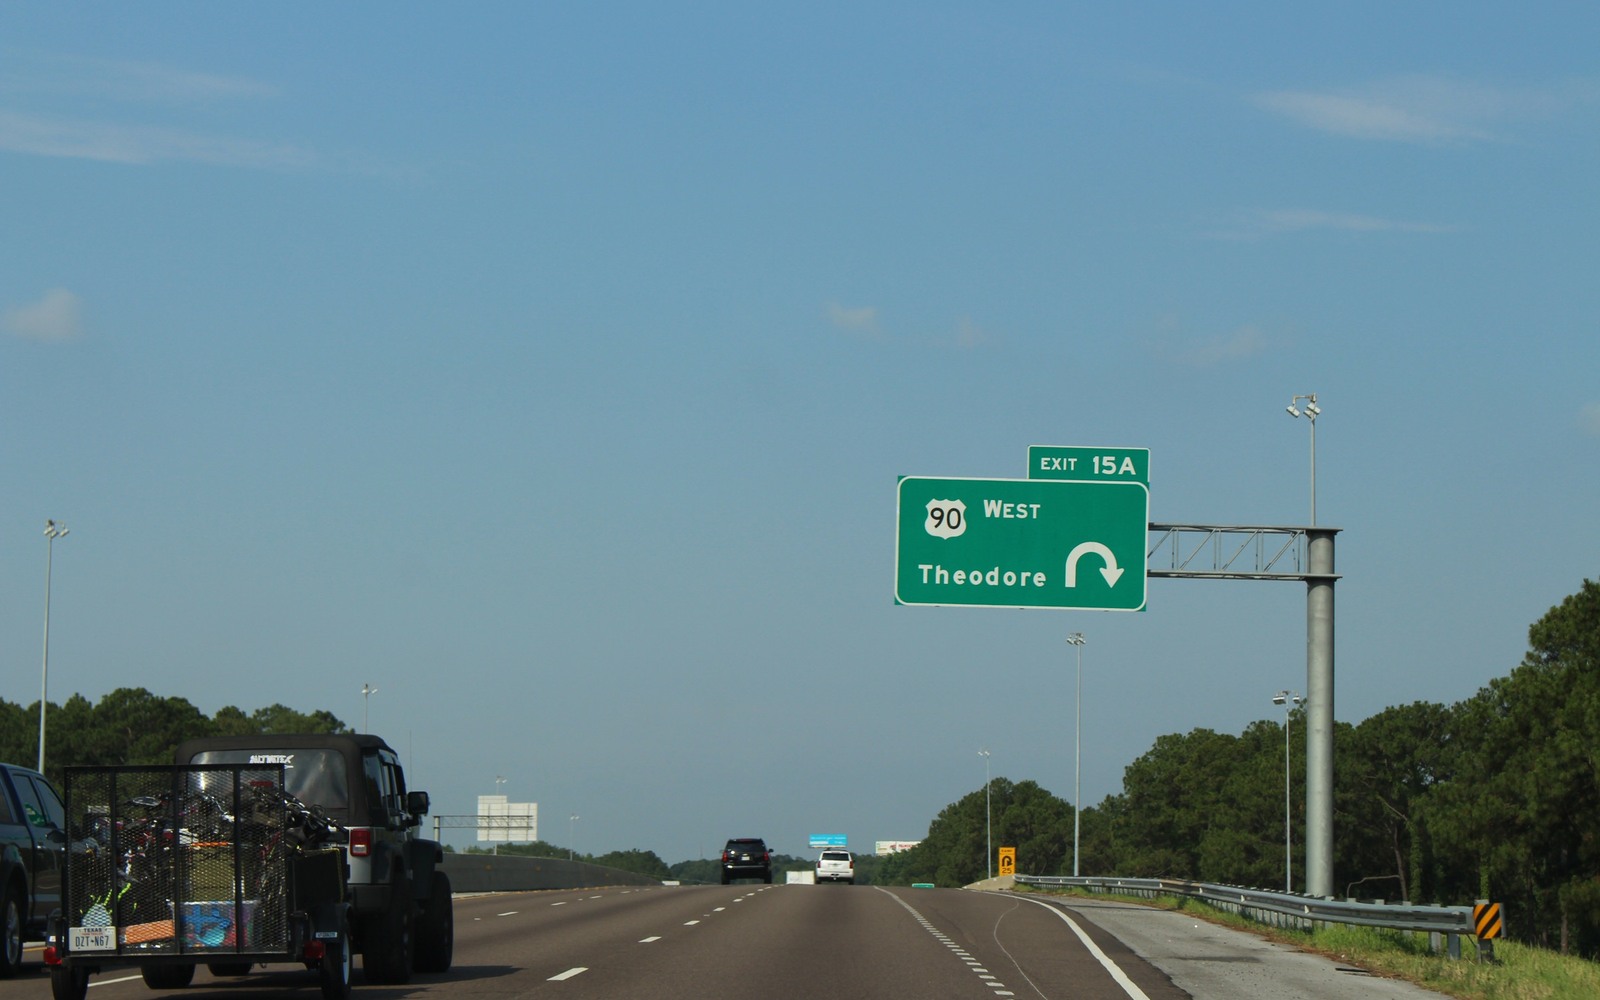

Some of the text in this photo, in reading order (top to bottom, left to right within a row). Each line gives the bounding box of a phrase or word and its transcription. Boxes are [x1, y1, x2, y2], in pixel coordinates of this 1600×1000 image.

[1040, 456, 1136, 475] EXIT 15A
[930, 507, 961, 530] 90
[983, 499, 1041, 519] WEST
[918, 564, 1047, 587] Theodore
